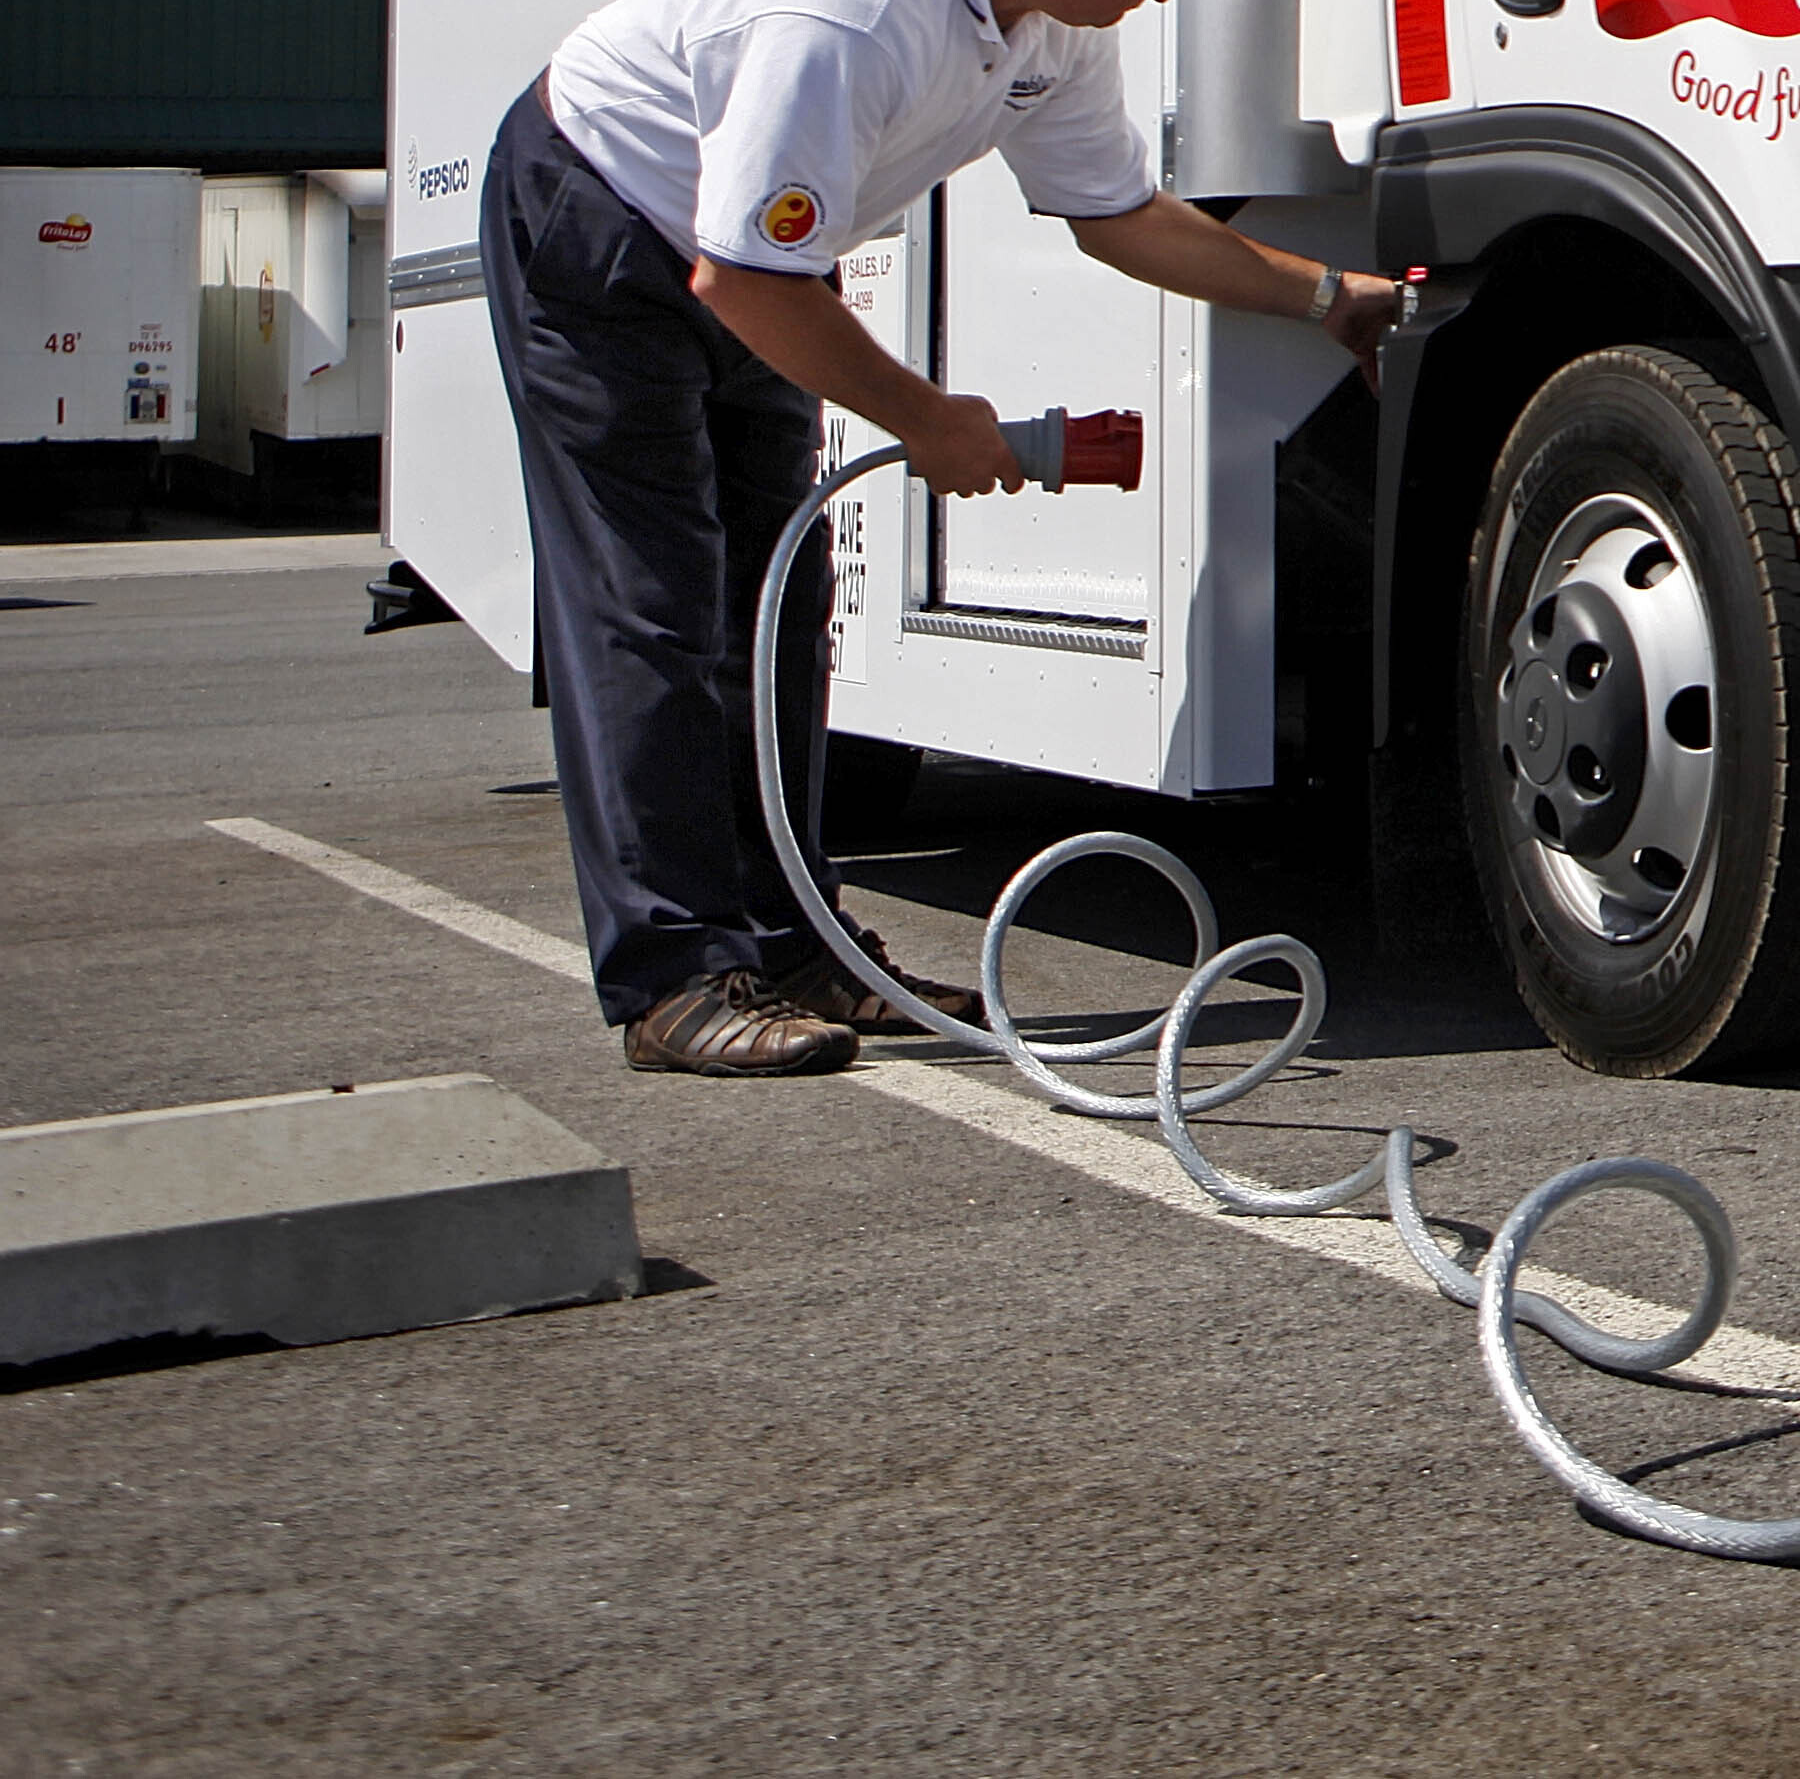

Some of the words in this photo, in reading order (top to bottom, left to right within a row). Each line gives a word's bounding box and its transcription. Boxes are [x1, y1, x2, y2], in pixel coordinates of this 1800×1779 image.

[1671, 50, 1763, 124] Good
[420, 158, 470, 201] PEPSICO
[881, 254, 892, 275] LP
[838, 500, 864, 554] AVE
[835, 560, 867, 616] 11237
